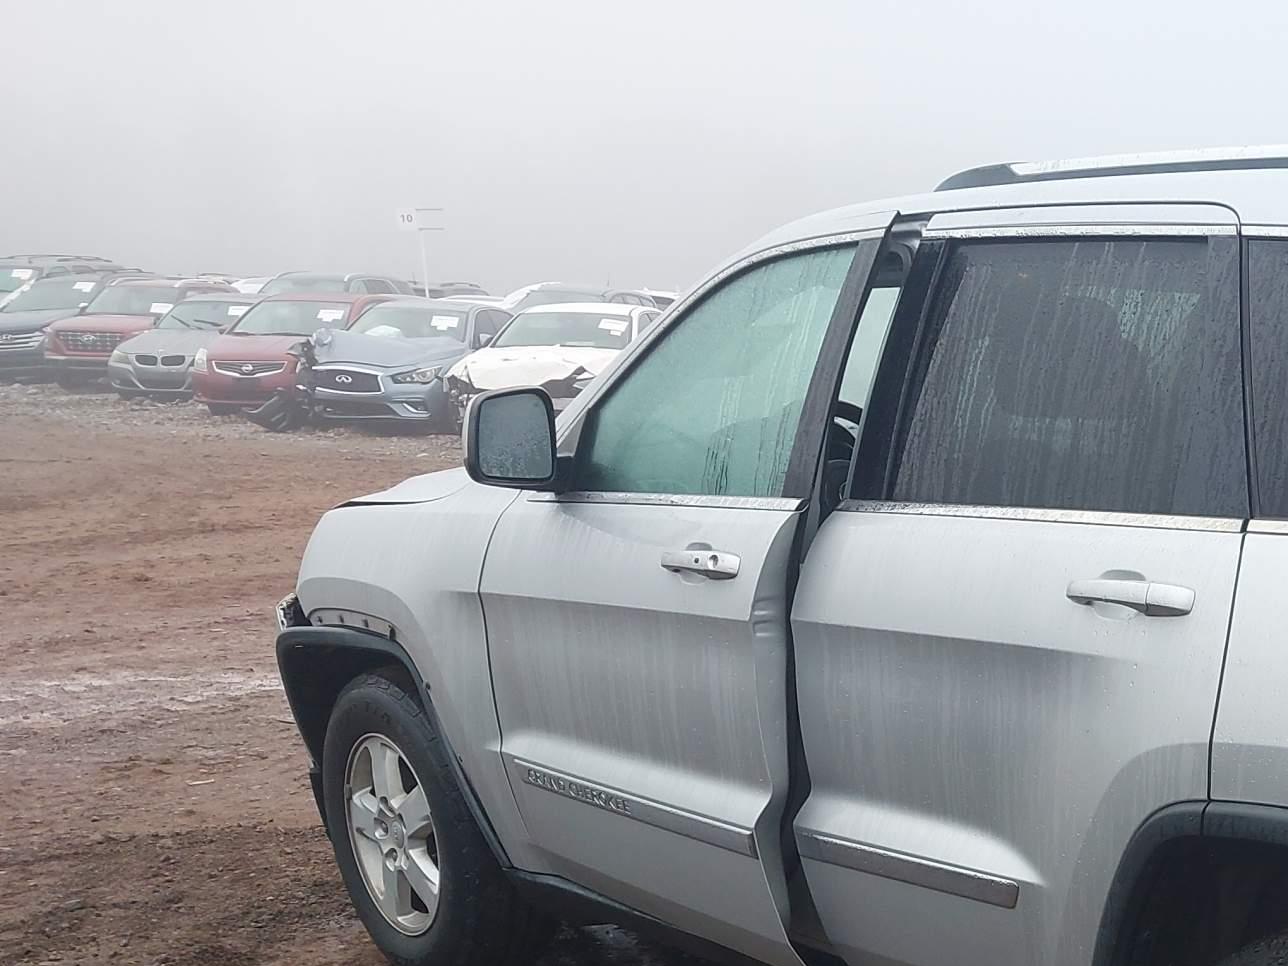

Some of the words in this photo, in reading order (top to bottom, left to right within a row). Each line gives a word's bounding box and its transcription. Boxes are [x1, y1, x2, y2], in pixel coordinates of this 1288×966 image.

[400, 213, 414, 224] 10
[527, 768, 566, 794] GRAND
[568, 782, 632, 816] CHEROKEE
